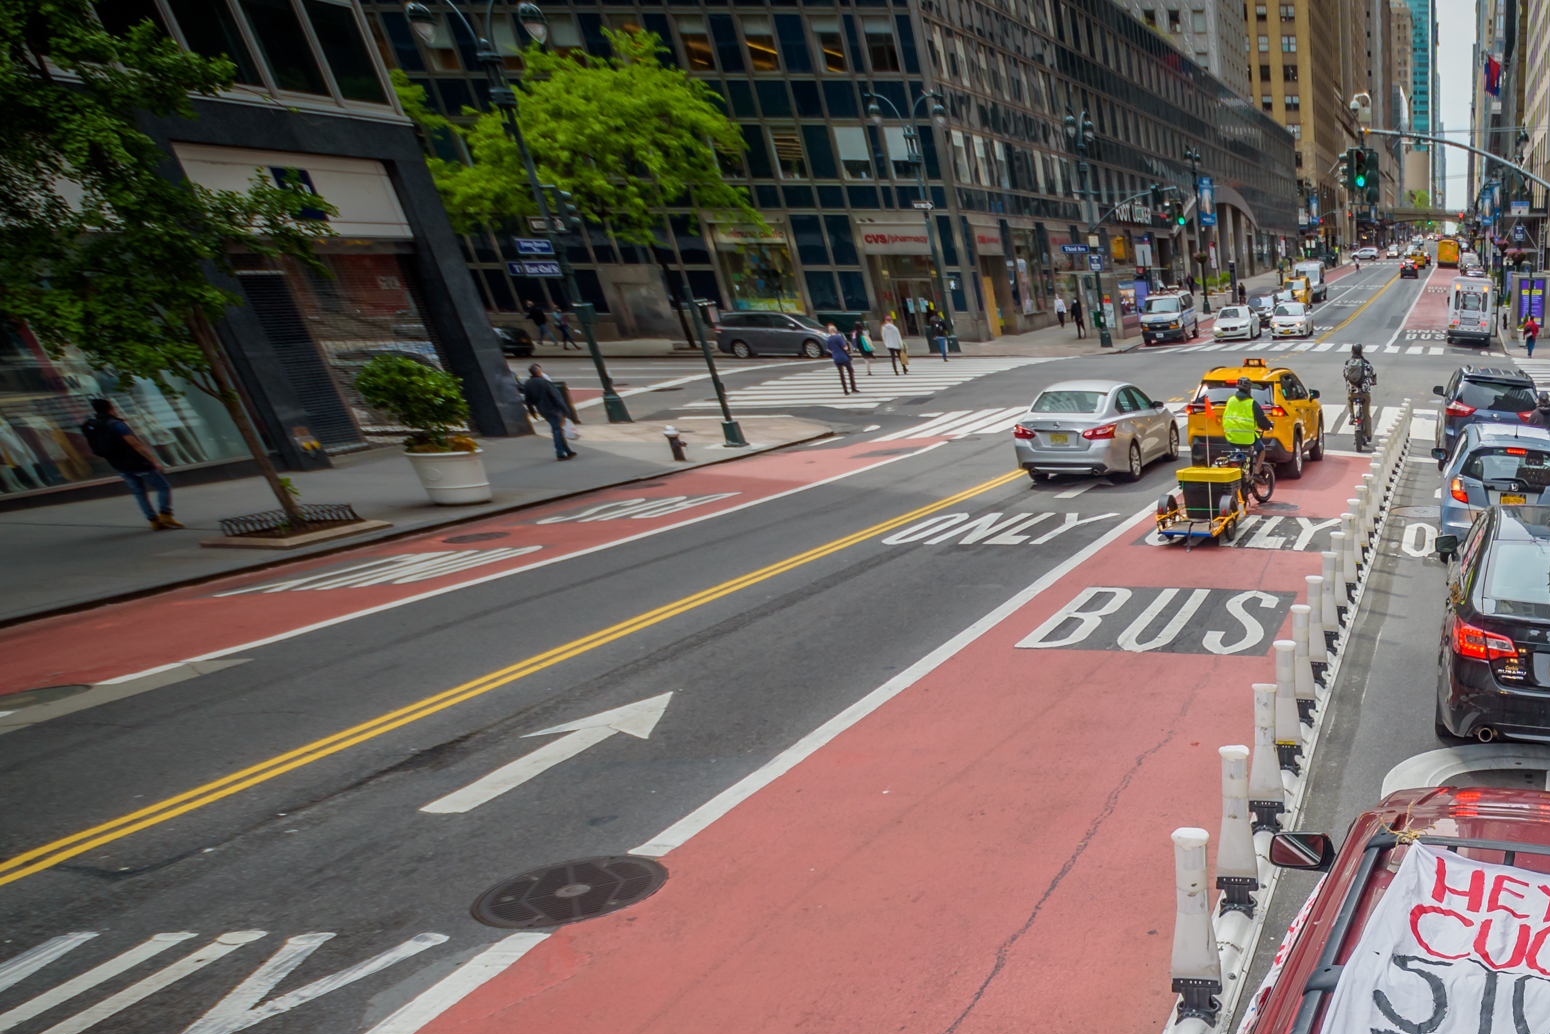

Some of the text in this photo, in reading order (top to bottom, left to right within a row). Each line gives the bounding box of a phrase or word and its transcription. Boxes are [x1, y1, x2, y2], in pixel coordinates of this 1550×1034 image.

[881, 511, 1121, 546] ONLY
[1013, 586, 1281, 656] BUS
[1497, 668, 1527, 676] SUBARU
